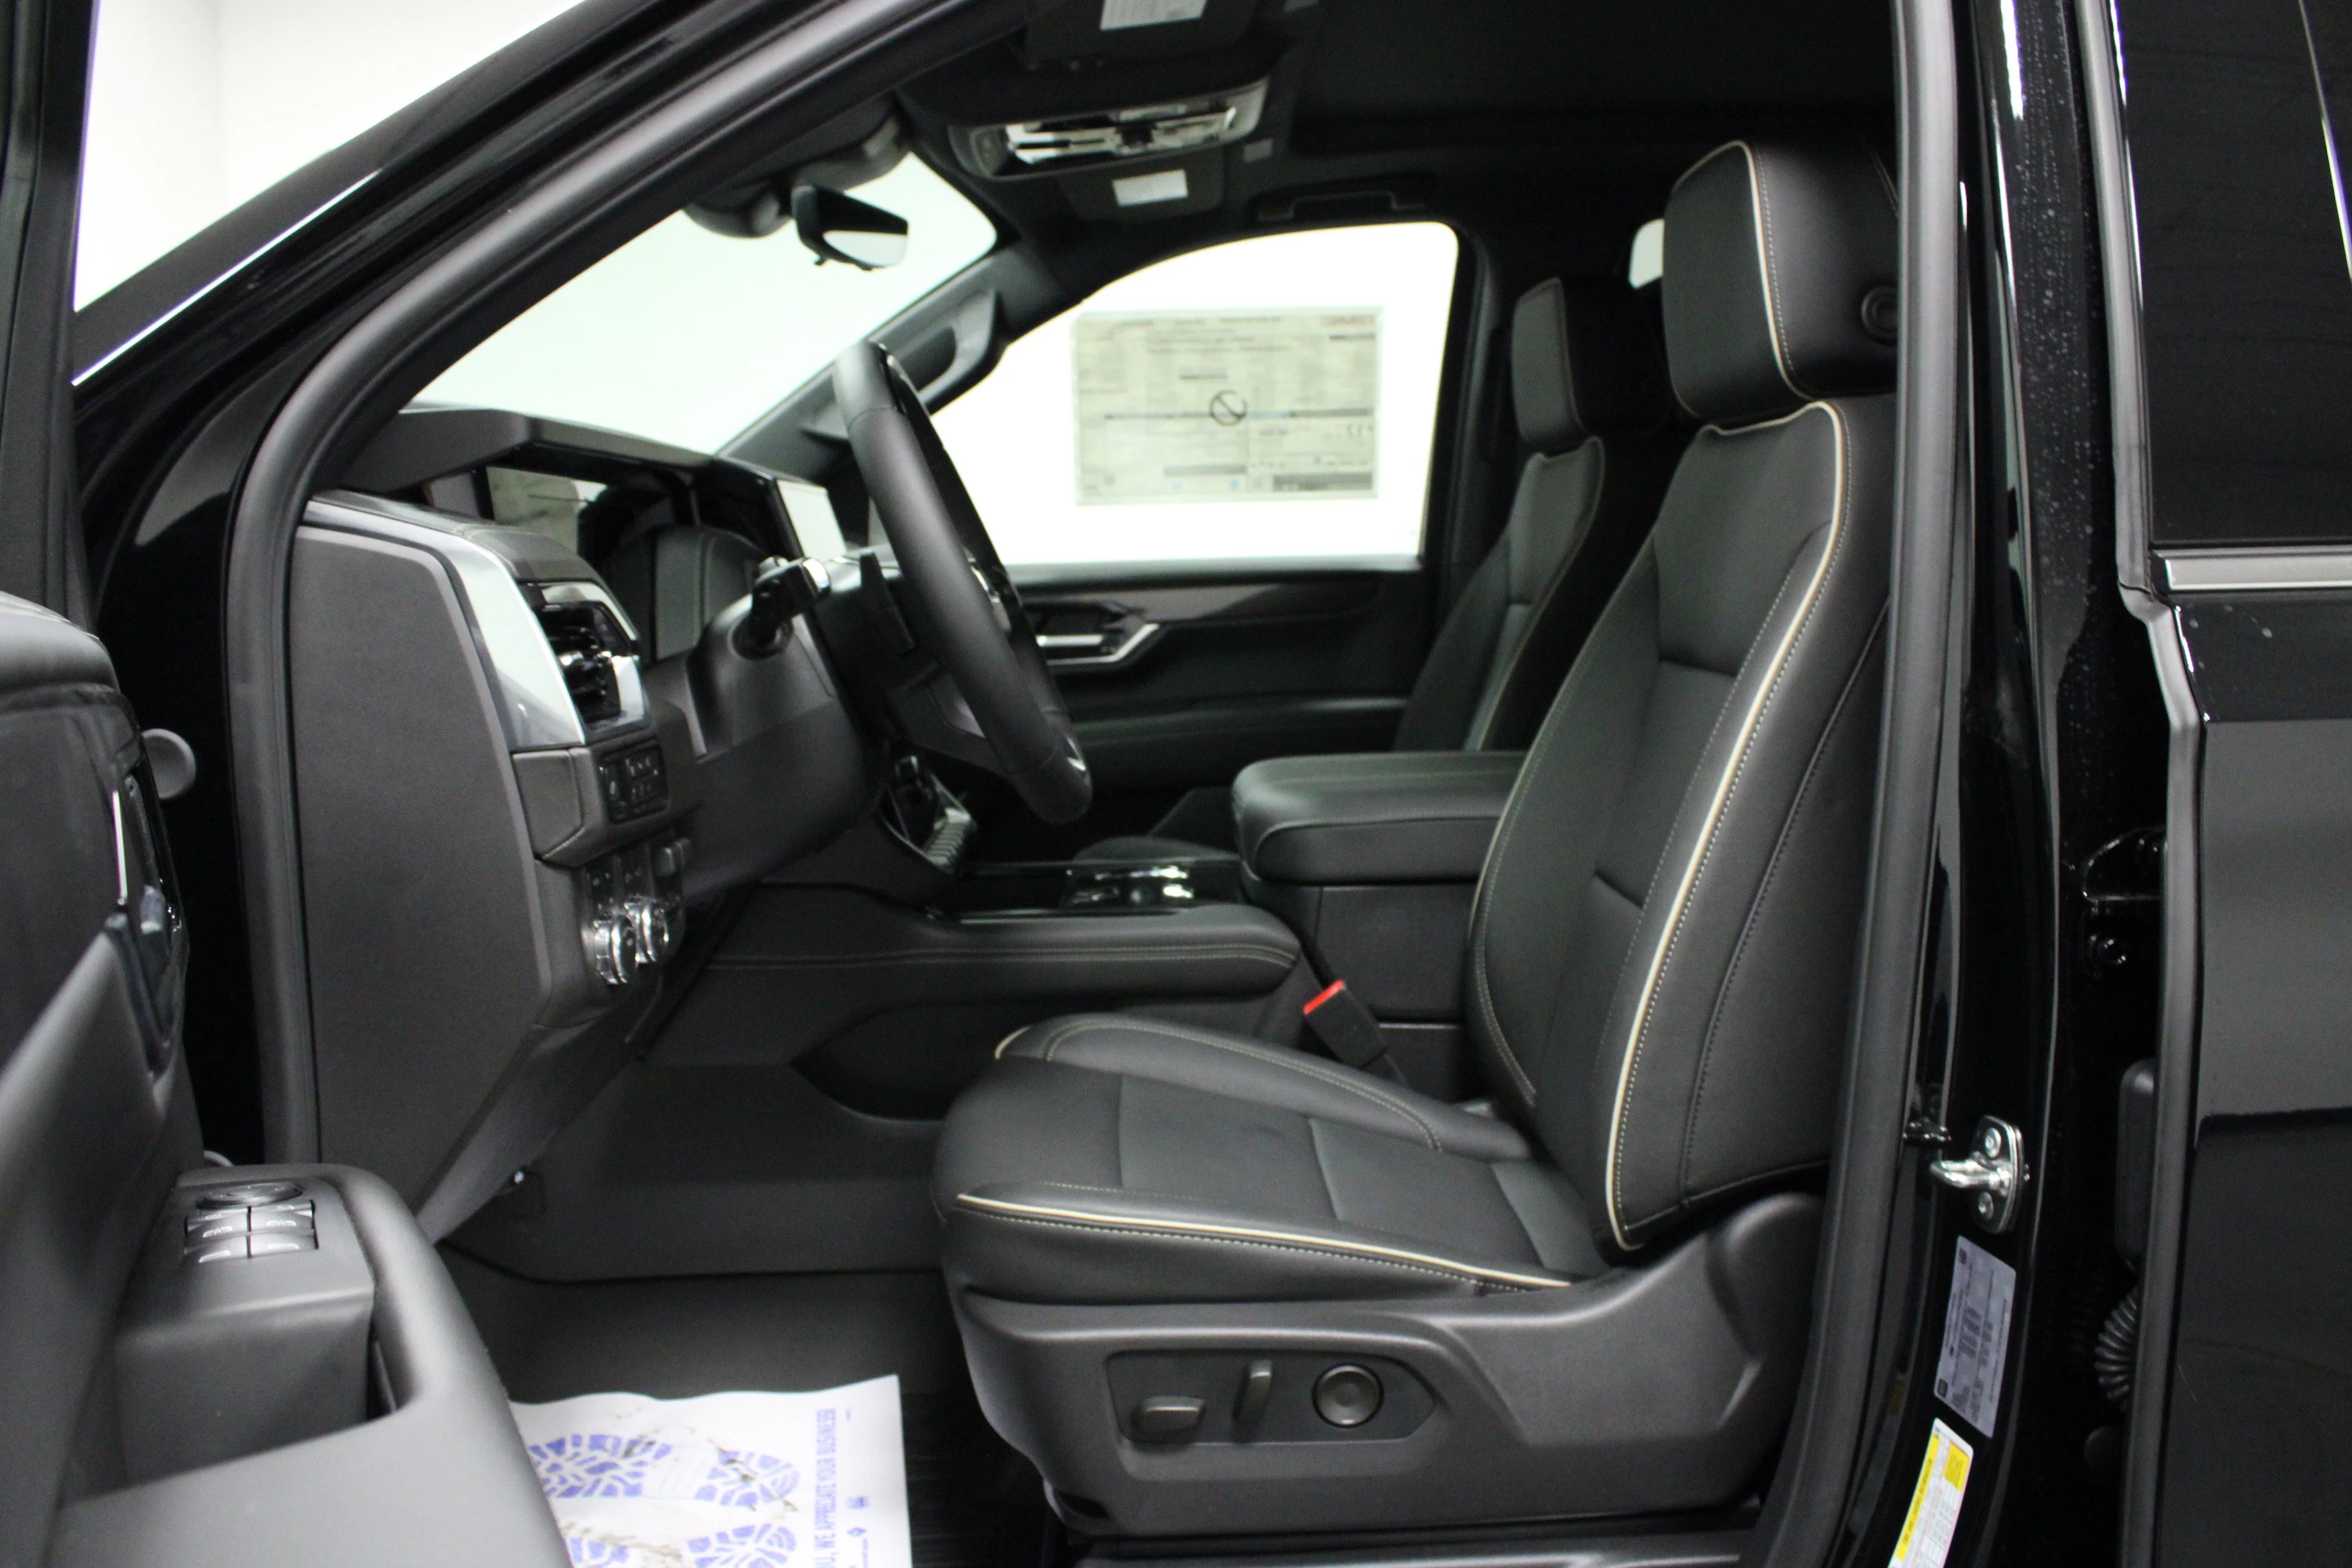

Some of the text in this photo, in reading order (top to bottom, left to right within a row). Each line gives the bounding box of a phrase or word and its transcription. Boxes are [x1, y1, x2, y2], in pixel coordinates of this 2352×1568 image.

[816, 1409, 836, 1455] BUSINESS
[815, 1457, 836, 1482] YOUR
[814, 1534, 836, 1550] WE
